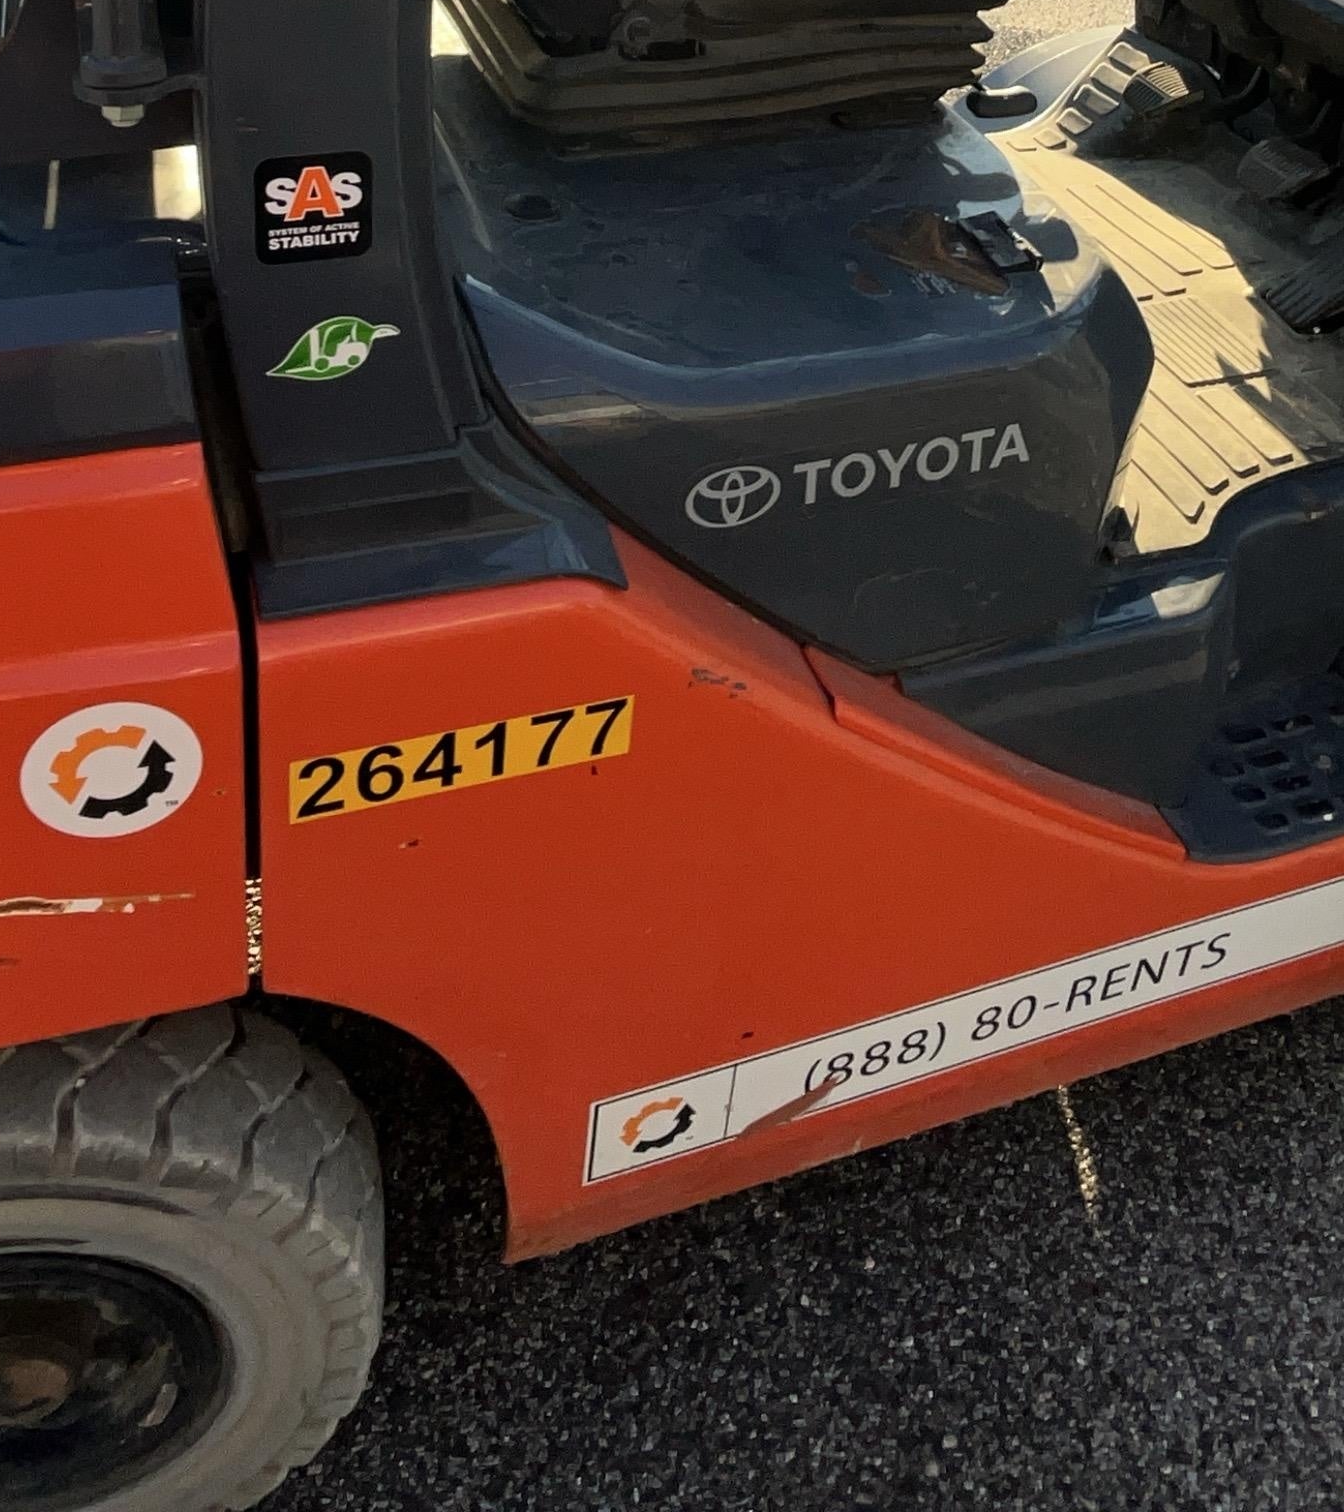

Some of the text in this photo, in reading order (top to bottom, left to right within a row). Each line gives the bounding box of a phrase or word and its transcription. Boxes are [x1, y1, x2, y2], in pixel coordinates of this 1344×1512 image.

[264, 165, 364, 223] SAS
[267, 221, 360, 238] SYSTEM OF ACTIVE
[268, 230, 360, 251] STABILITY
[792, 423, 1030, 506] TOYOTA
[295, 697, 629, 820] 264177
[804, 931, 1232, 1094] (888) 80-RENTS
